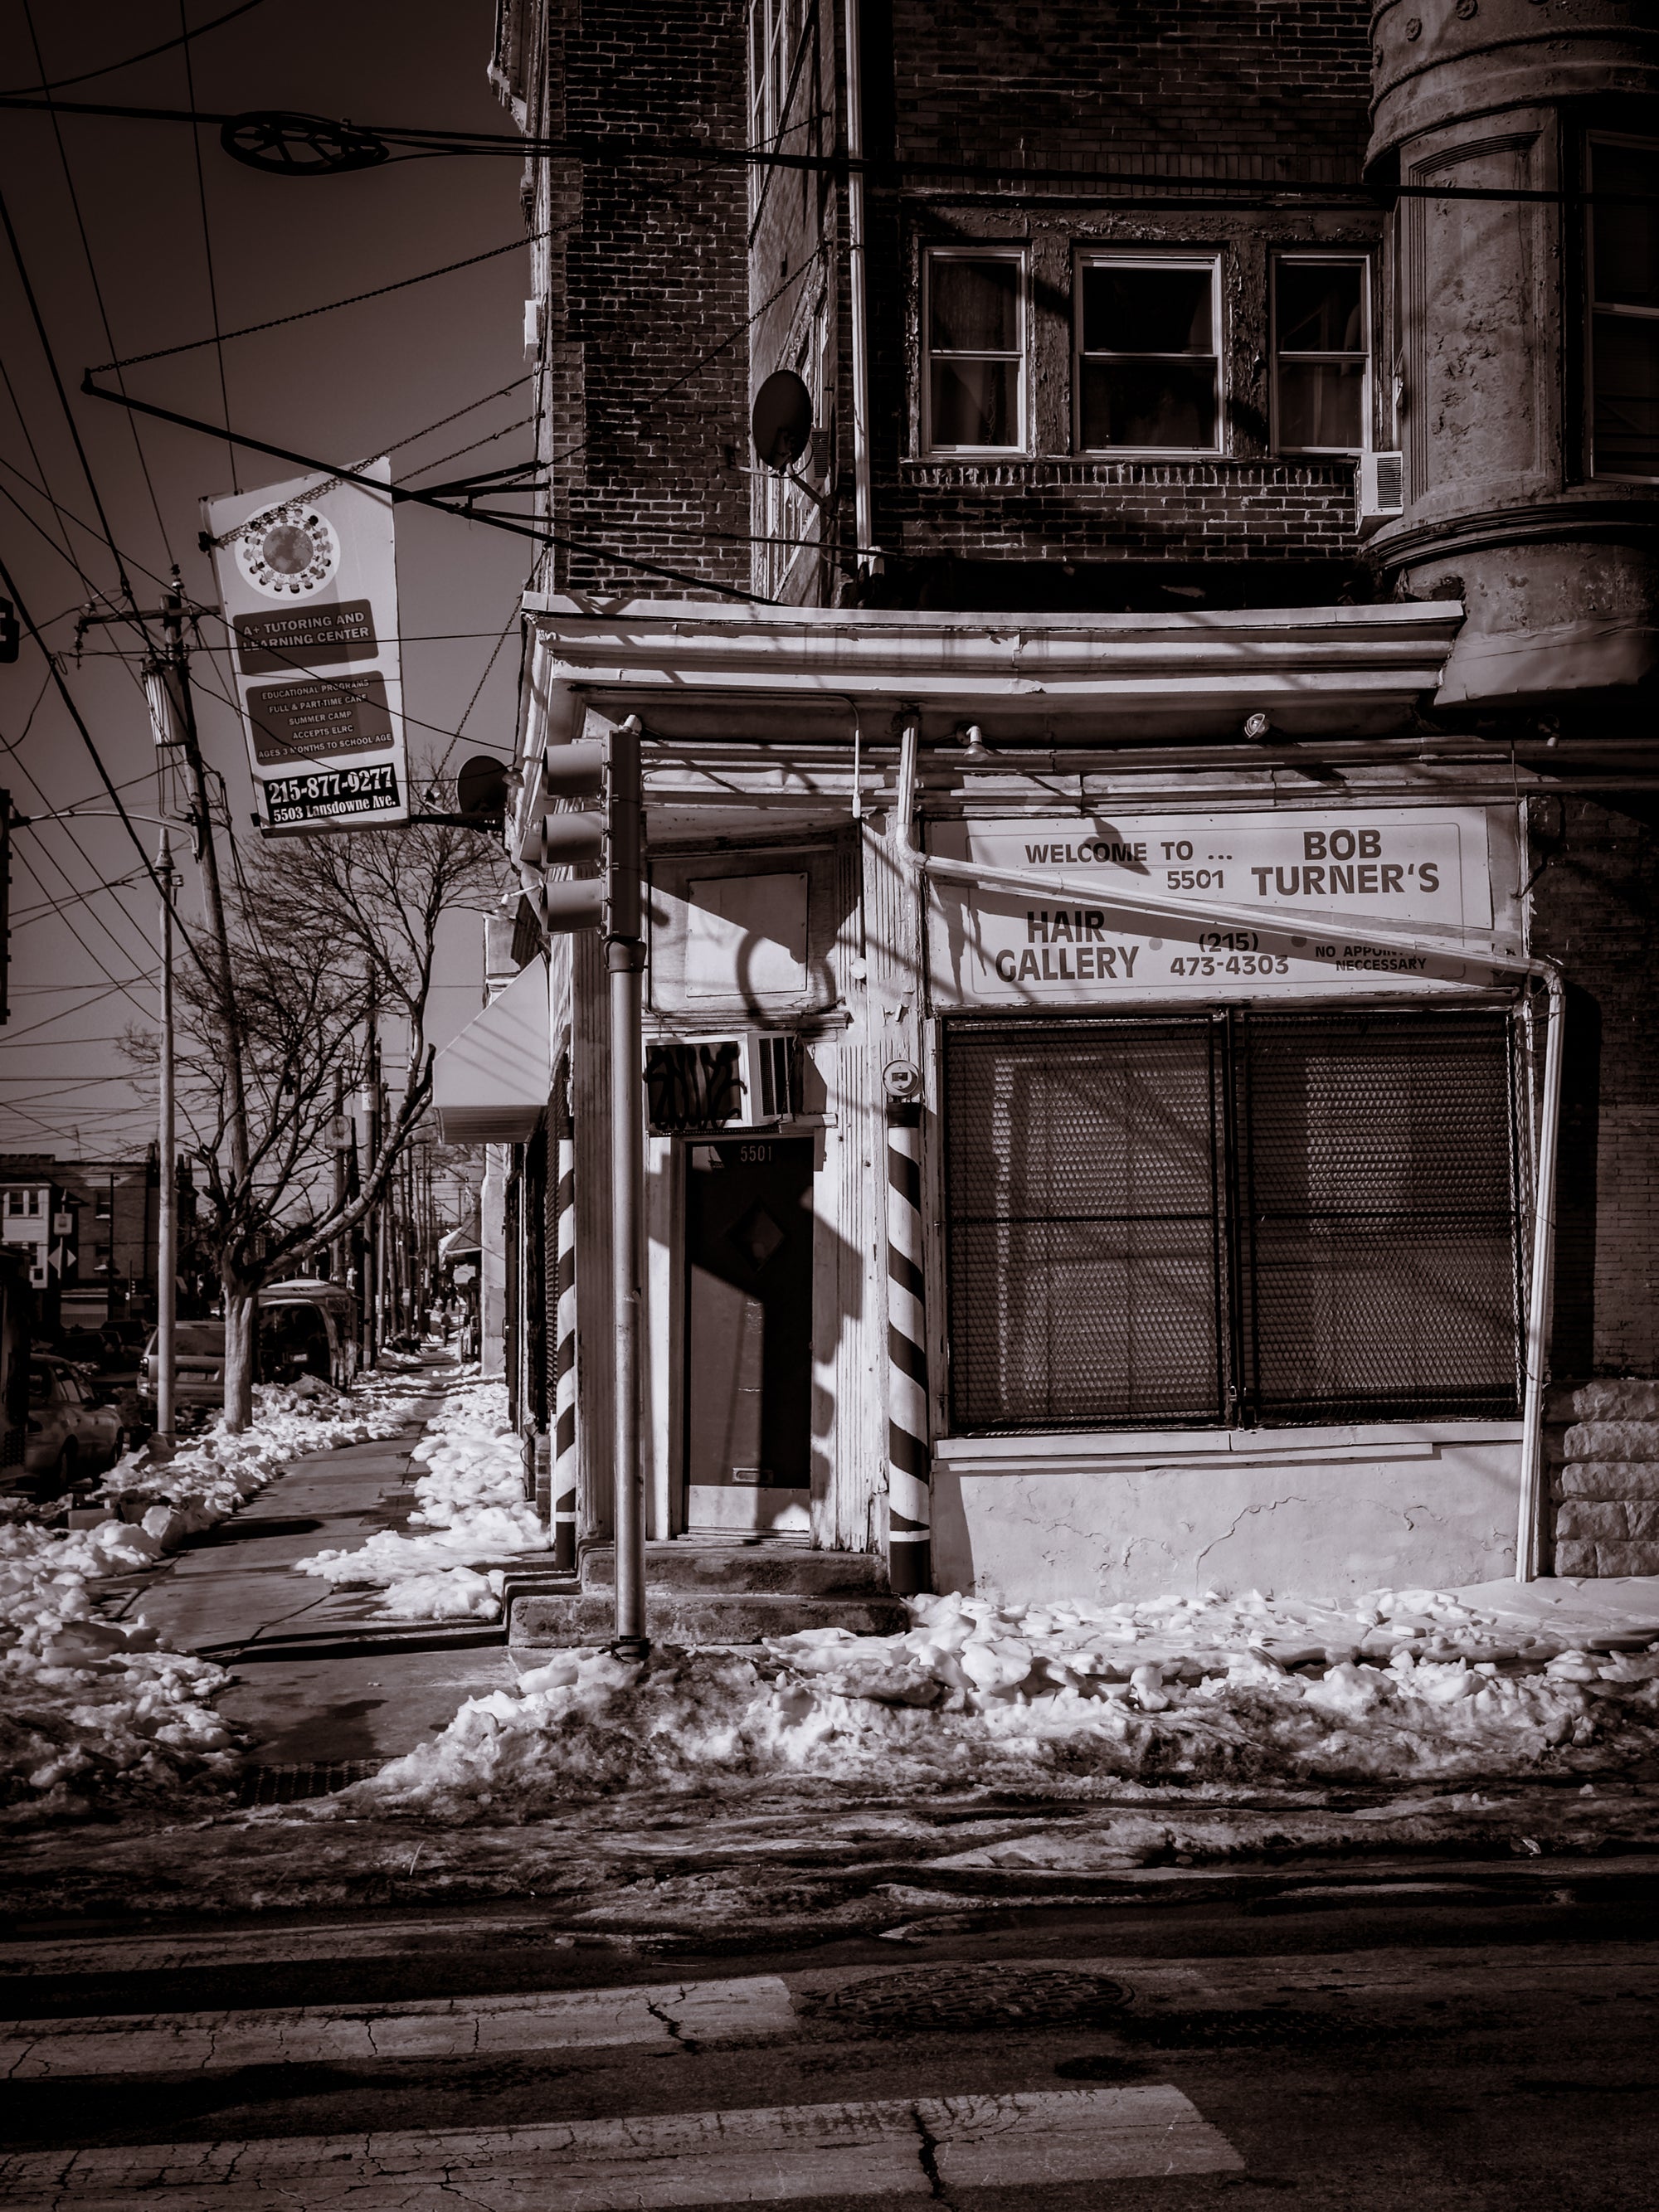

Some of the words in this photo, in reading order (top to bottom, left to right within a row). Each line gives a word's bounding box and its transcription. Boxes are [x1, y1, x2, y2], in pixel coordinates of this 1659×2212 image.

[243, 625, 260, 636] A+
[264, 616, 331, 634] TUTORING
[336, 612, 364, 625] AND
[243, 634, 313, 652] LEARNING
[317, 627, 369, 642] CENTER
[262, 685, 319, 700] EDUCATIONAL
[322, 678, 369, 693] PROGRAMS
[269, 704, 289, 713] FULL
[291, 702, 298, 711] &
[289, 714, 326, 726] SUMMER
[328, 710, 352, 720] CAMP
[293, 728, 329, 739] ACCEPTS
[332, 725, 353, 735] ELRC
[258, 748, 281, 759] AGES
[290, 742, 325, 754] MONTHS
[327, 741, 338, 750] TO
[339, 737, 373, 747] SCHOOL
[375, 733, 392, 742] AGE
[268, 766, 392, 804] 215-877-9277
[274, 806, 304, 823] 5503
[306, 797, 370, 818] Lansdowne
[373, 795, 397, 809] Ave.
[1024, 842, 1147, 863] WELCOME
[1160, 840, 1194, 861] TO
[1303, 829, 1382, 861] BOB
[1167, 869, 1224, 890] 5501
[1251, 863, 1440, 896] TURNER'S
[1027, 910, 1106, 943] HAIR
[1199, 932, 1258, 952] (215)
[1315, 946, 1336, 957] NO
[995, 946, 1140, 983] GALLERY
[1170, 955, 1289, 976] 473-4303
[1335, 957, 1427, 971] NECCESSARY
[741, 1145, 772, 1162] 5501
